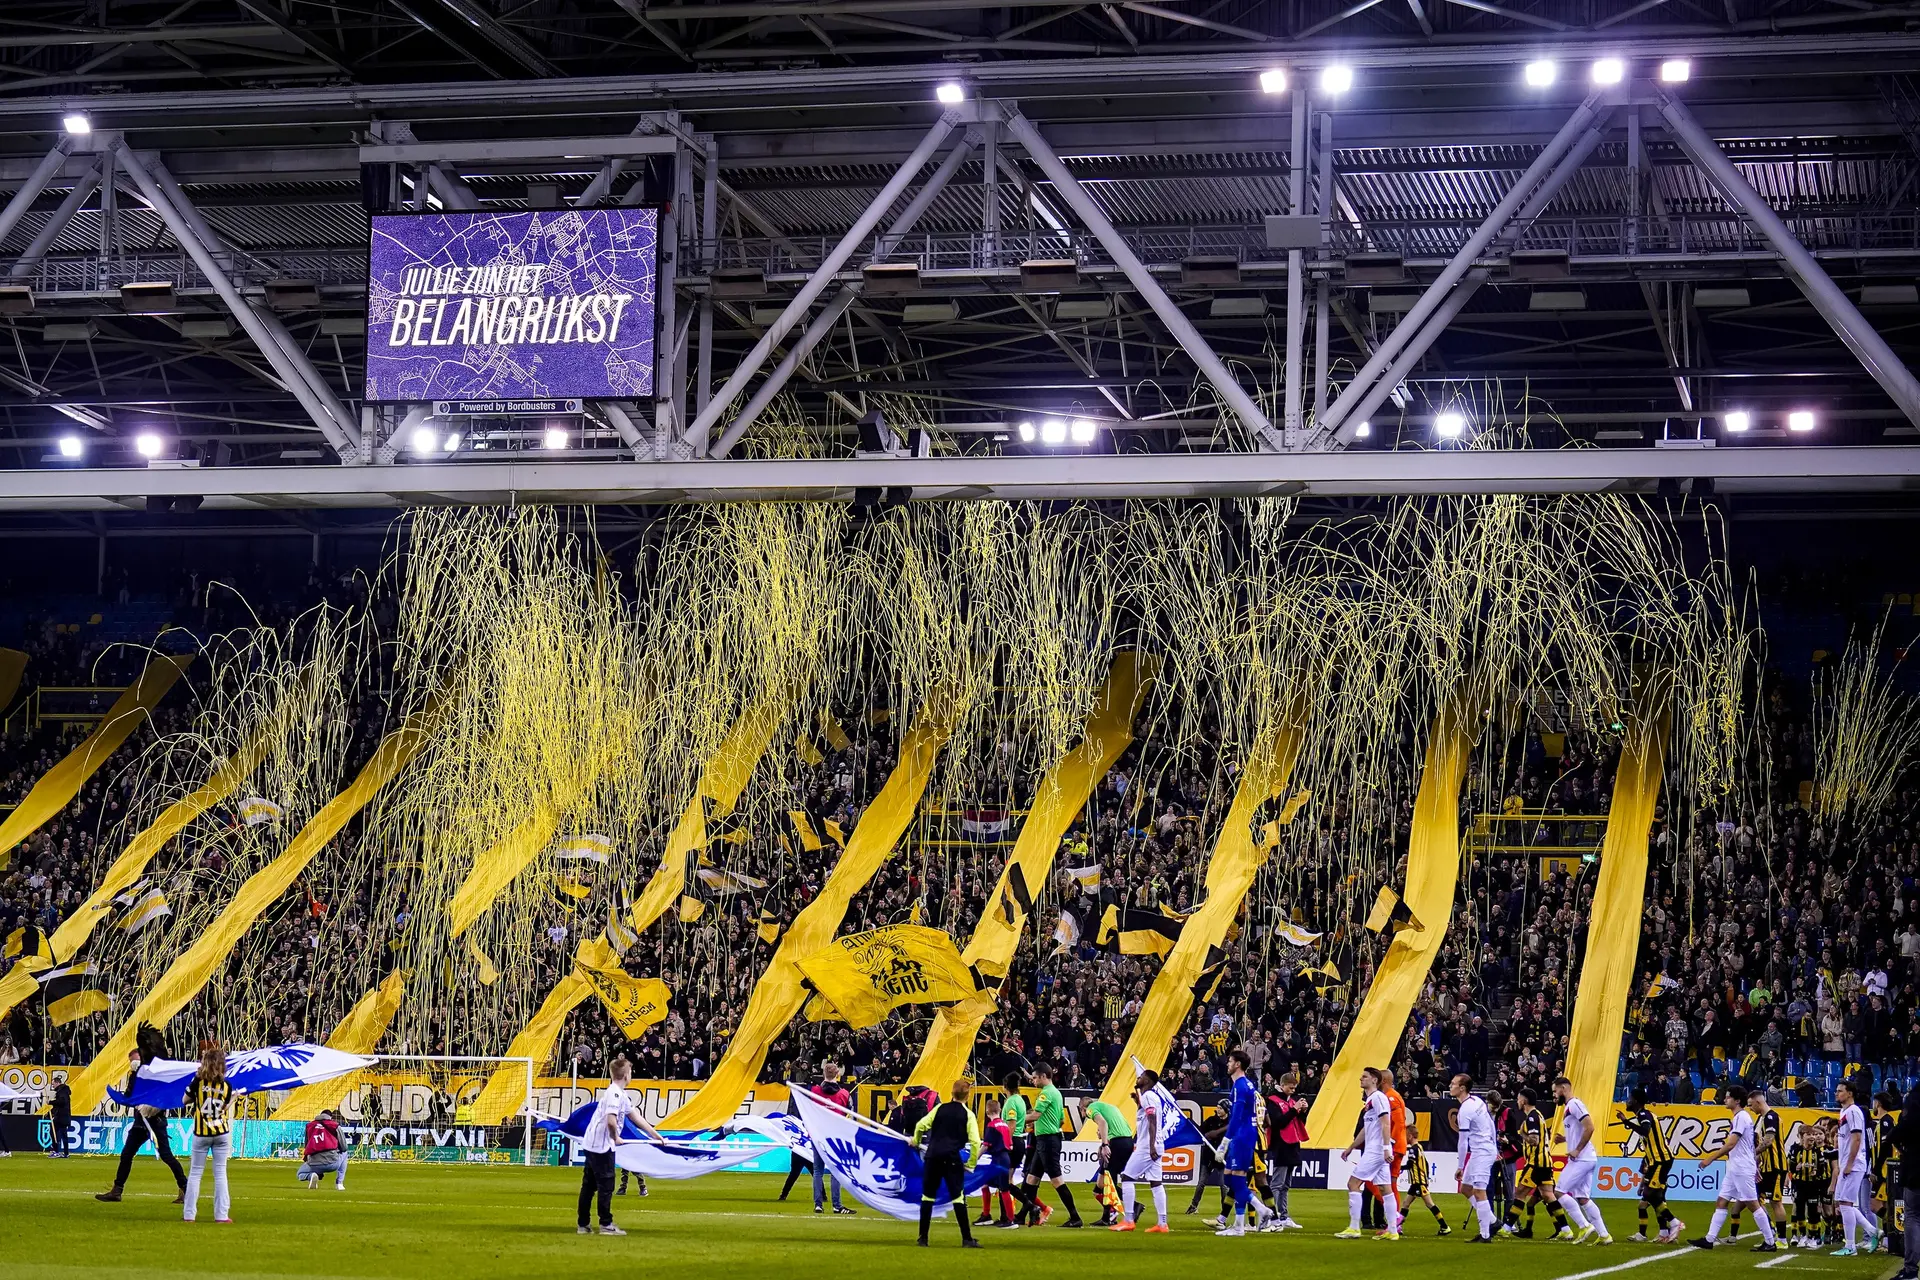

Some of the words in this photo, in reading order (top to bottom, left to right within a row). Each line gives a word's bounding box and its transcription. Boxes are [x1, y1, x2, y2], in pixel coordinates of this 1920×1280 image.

[402, 268, 463, 296] JULLIE
[461, 267, 503, 295] ZIJN
[504, 265, 545, 293] HET
[389, 294, 632, 347] BELANGRIJKST
[459, 402, 494, 412] Powered
[496, 403, 505, 413] by
[507, 401, 556, 412] Bordbusters
[370, 1148, 416, 1161] bet365
[1667, 1168, 1719, 1191] obiel
